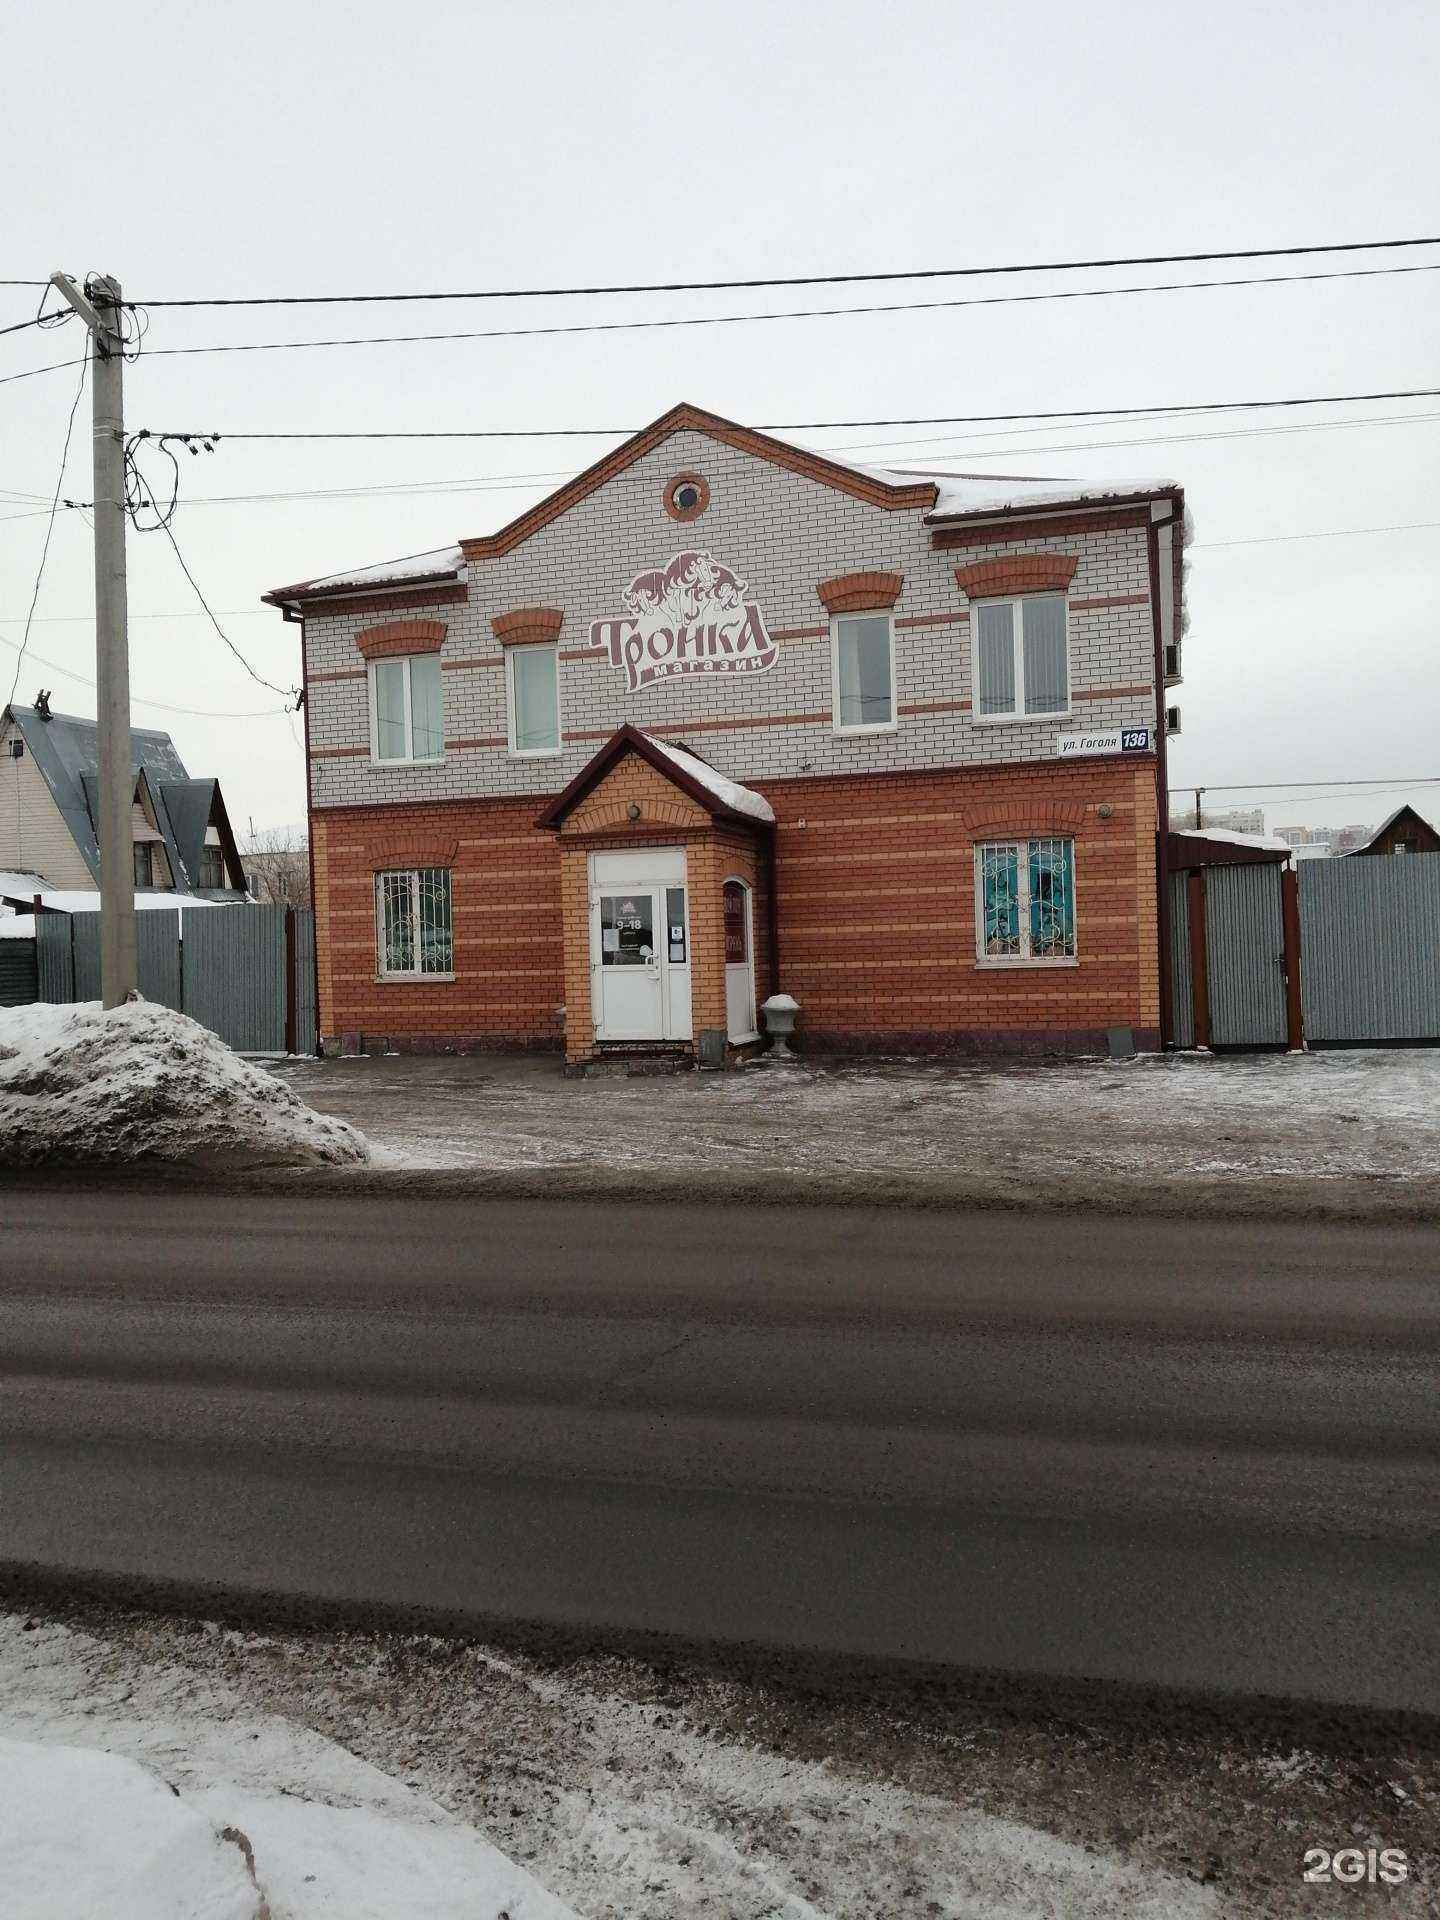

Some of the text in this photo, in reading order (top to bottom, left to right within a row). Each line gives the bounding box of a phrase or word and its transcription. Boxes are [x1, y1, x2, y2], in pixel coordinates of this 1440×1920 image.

[1063, 733, 1146, 752] ул. Гоголя 136
